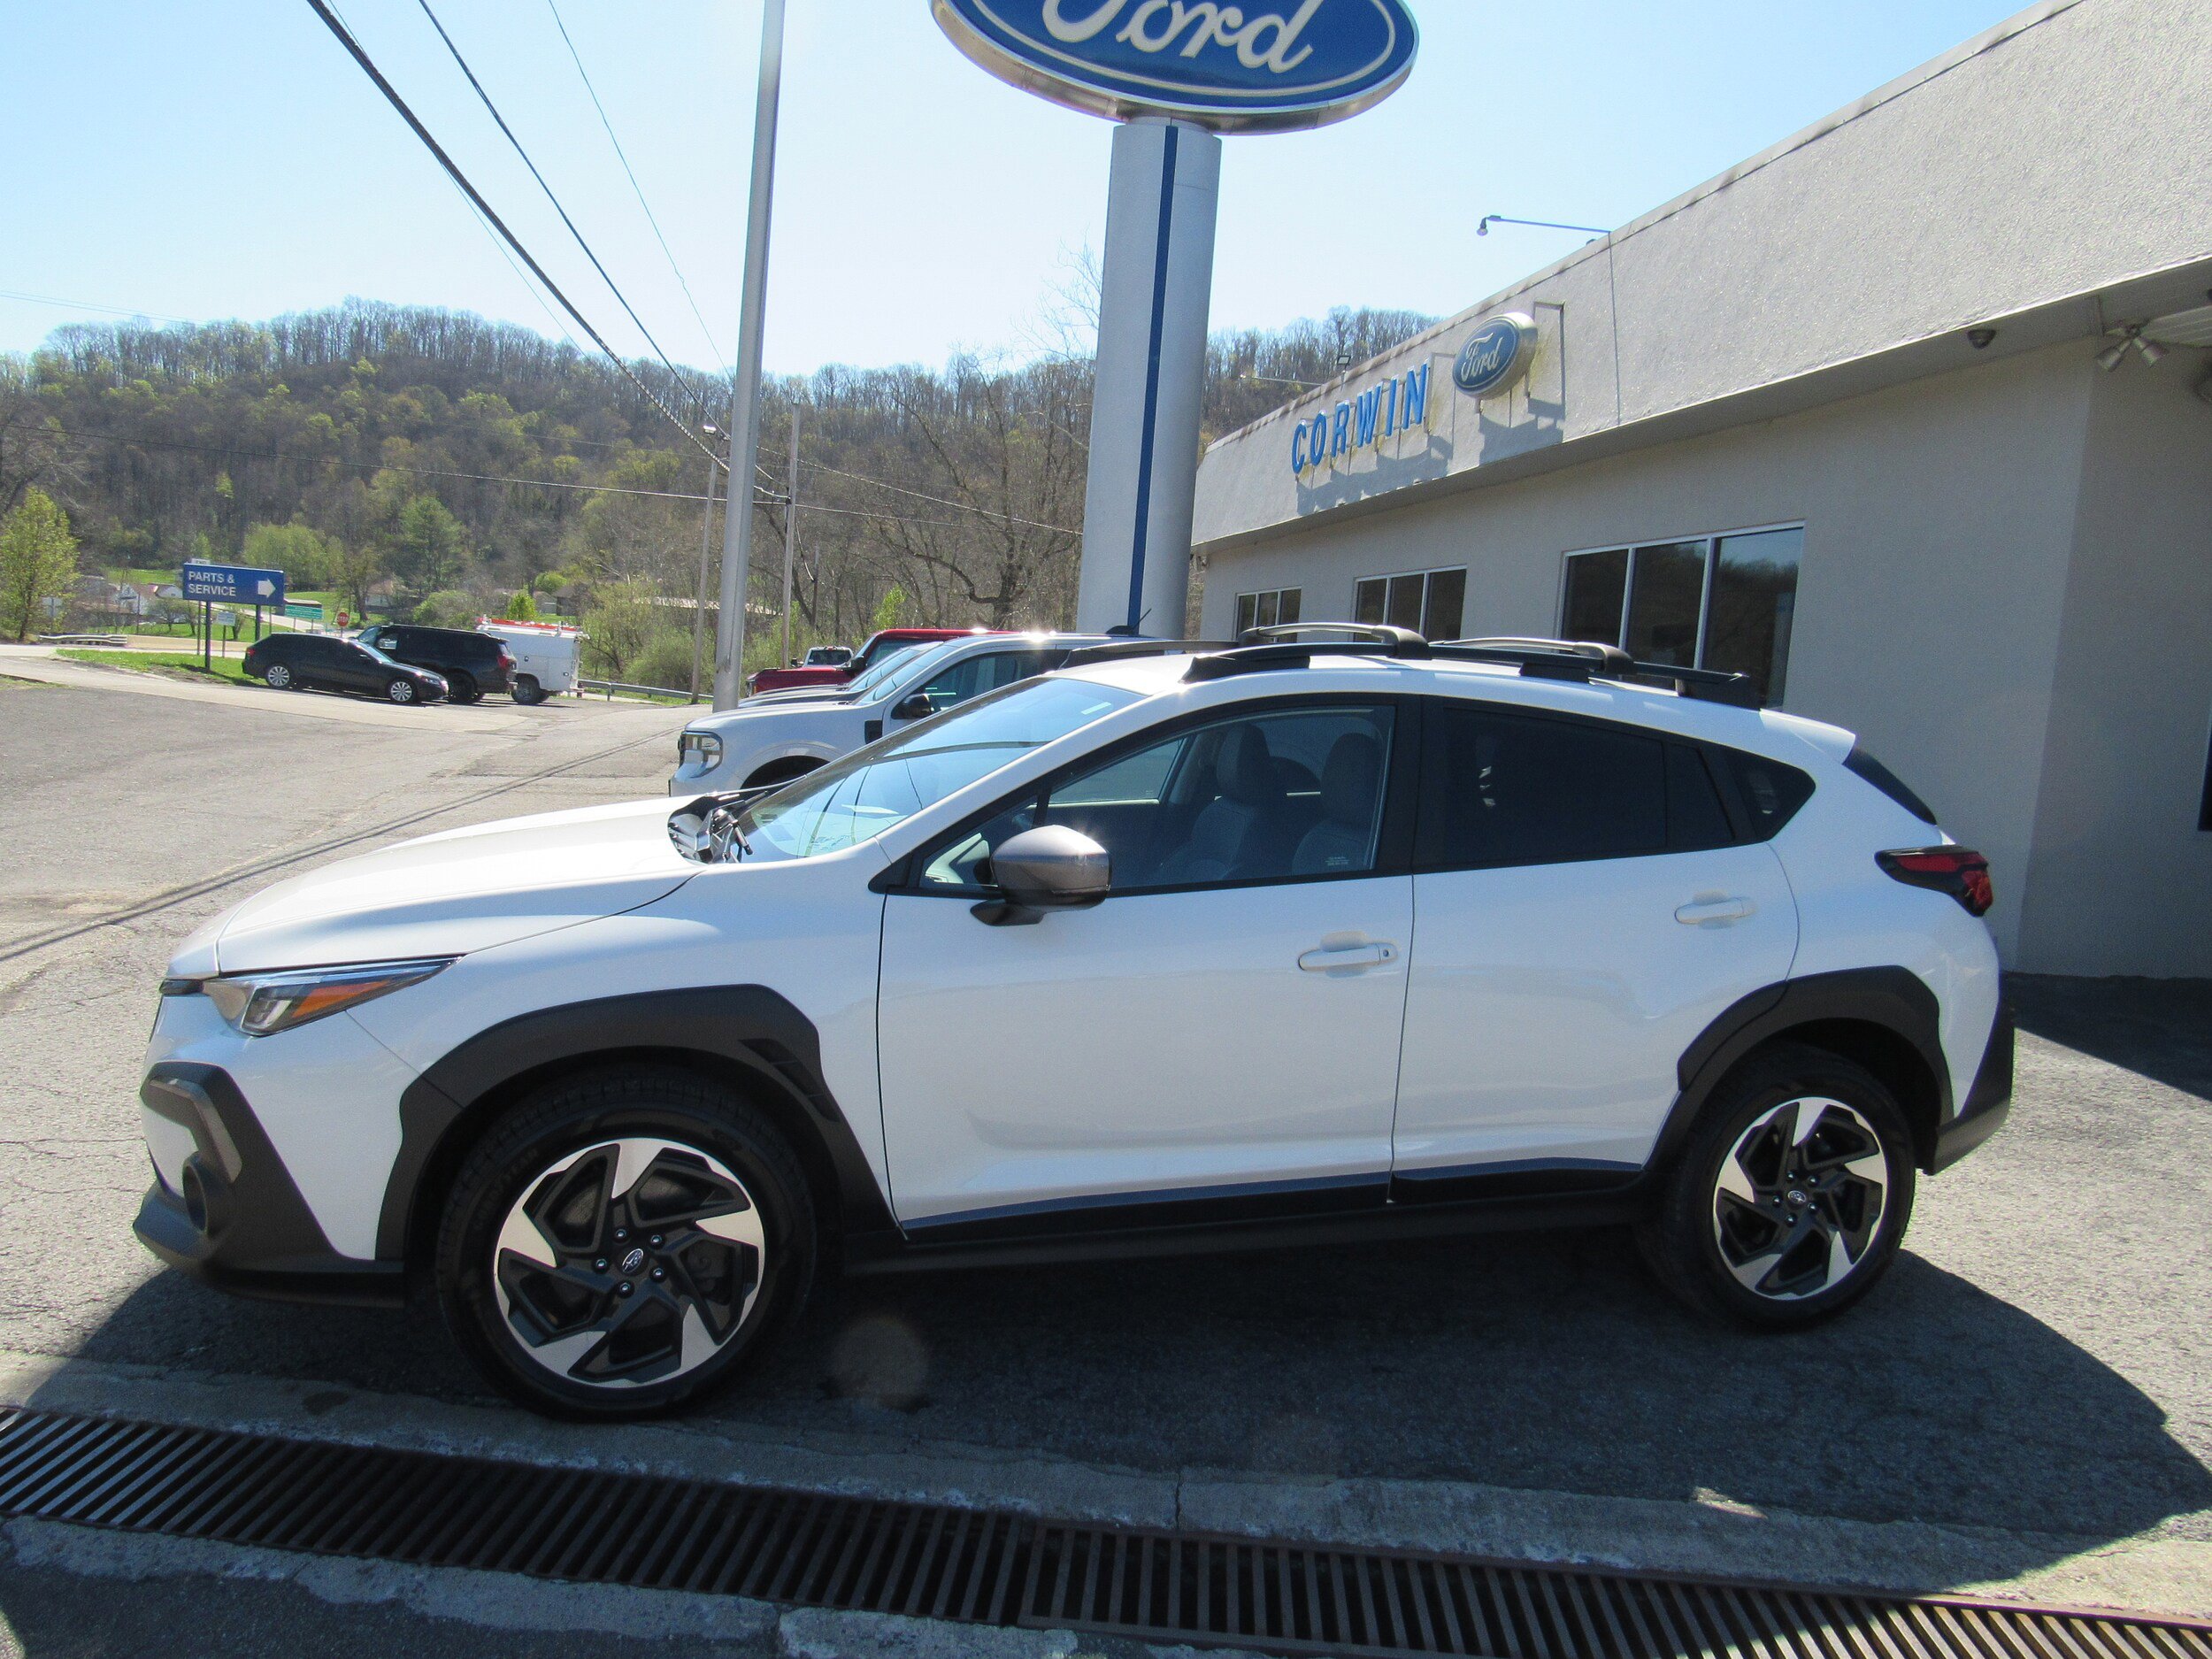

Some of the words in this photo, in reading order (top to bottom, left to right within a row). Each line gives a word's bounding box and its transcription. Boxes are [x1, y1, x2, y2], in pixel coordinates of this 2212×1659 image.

[1461, 332, 1504, 382] Ford
[1291, 357, 1431, 474] CORWIN
[188, 571, 225, 583] PARTS
[227, 573, 234, 584] &
[188, 583, 236, 596] SERVICE
